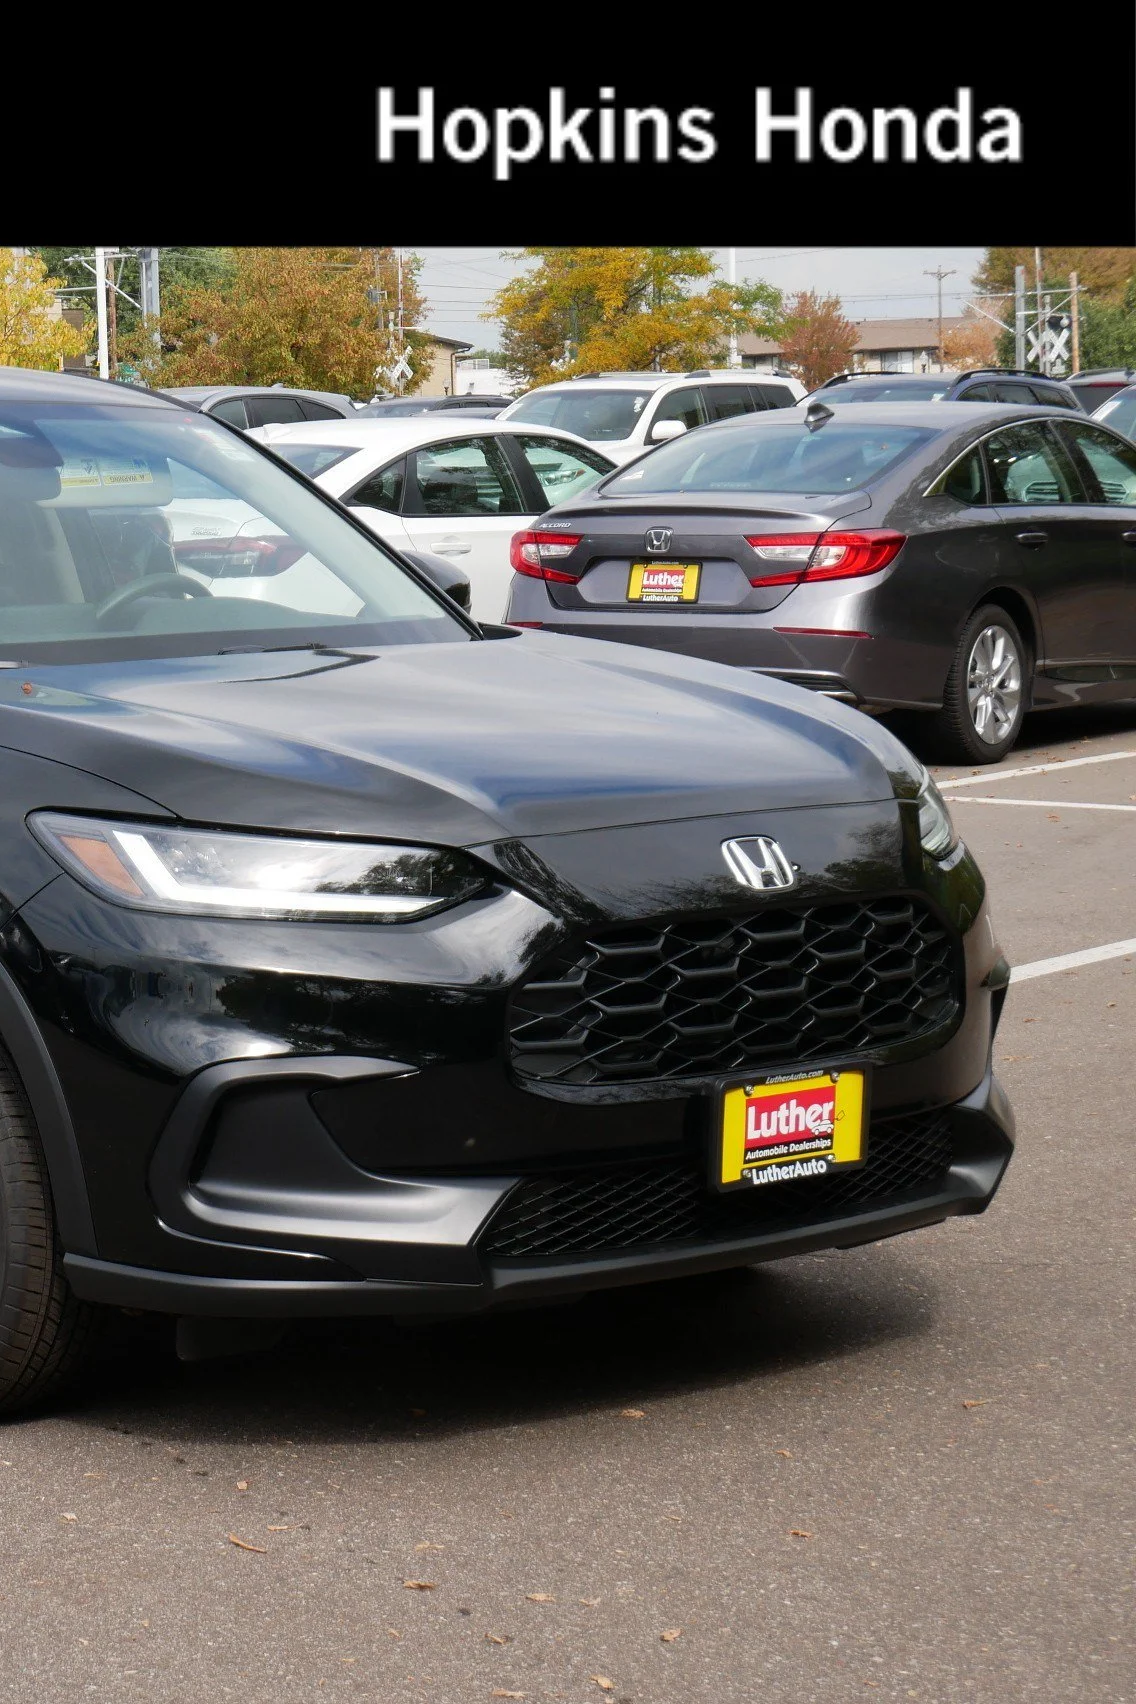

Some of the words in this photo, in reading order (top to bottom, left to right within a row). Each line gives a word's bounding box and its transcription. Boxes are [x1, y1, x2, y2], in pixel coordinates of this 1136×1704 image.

[642, 571, 685, 586] Luther
[642, 594, 679, 602] LutherAuto
[765, 1070, 824, 1085] LutherAuto.com
[747, 1098, 834, 1140] Luther
[745, 1144, 788, 1160] Automobile
[789, 1138, 831, 1153] Dealerships
[751, 1158, 827, 1185] LutherAuto
